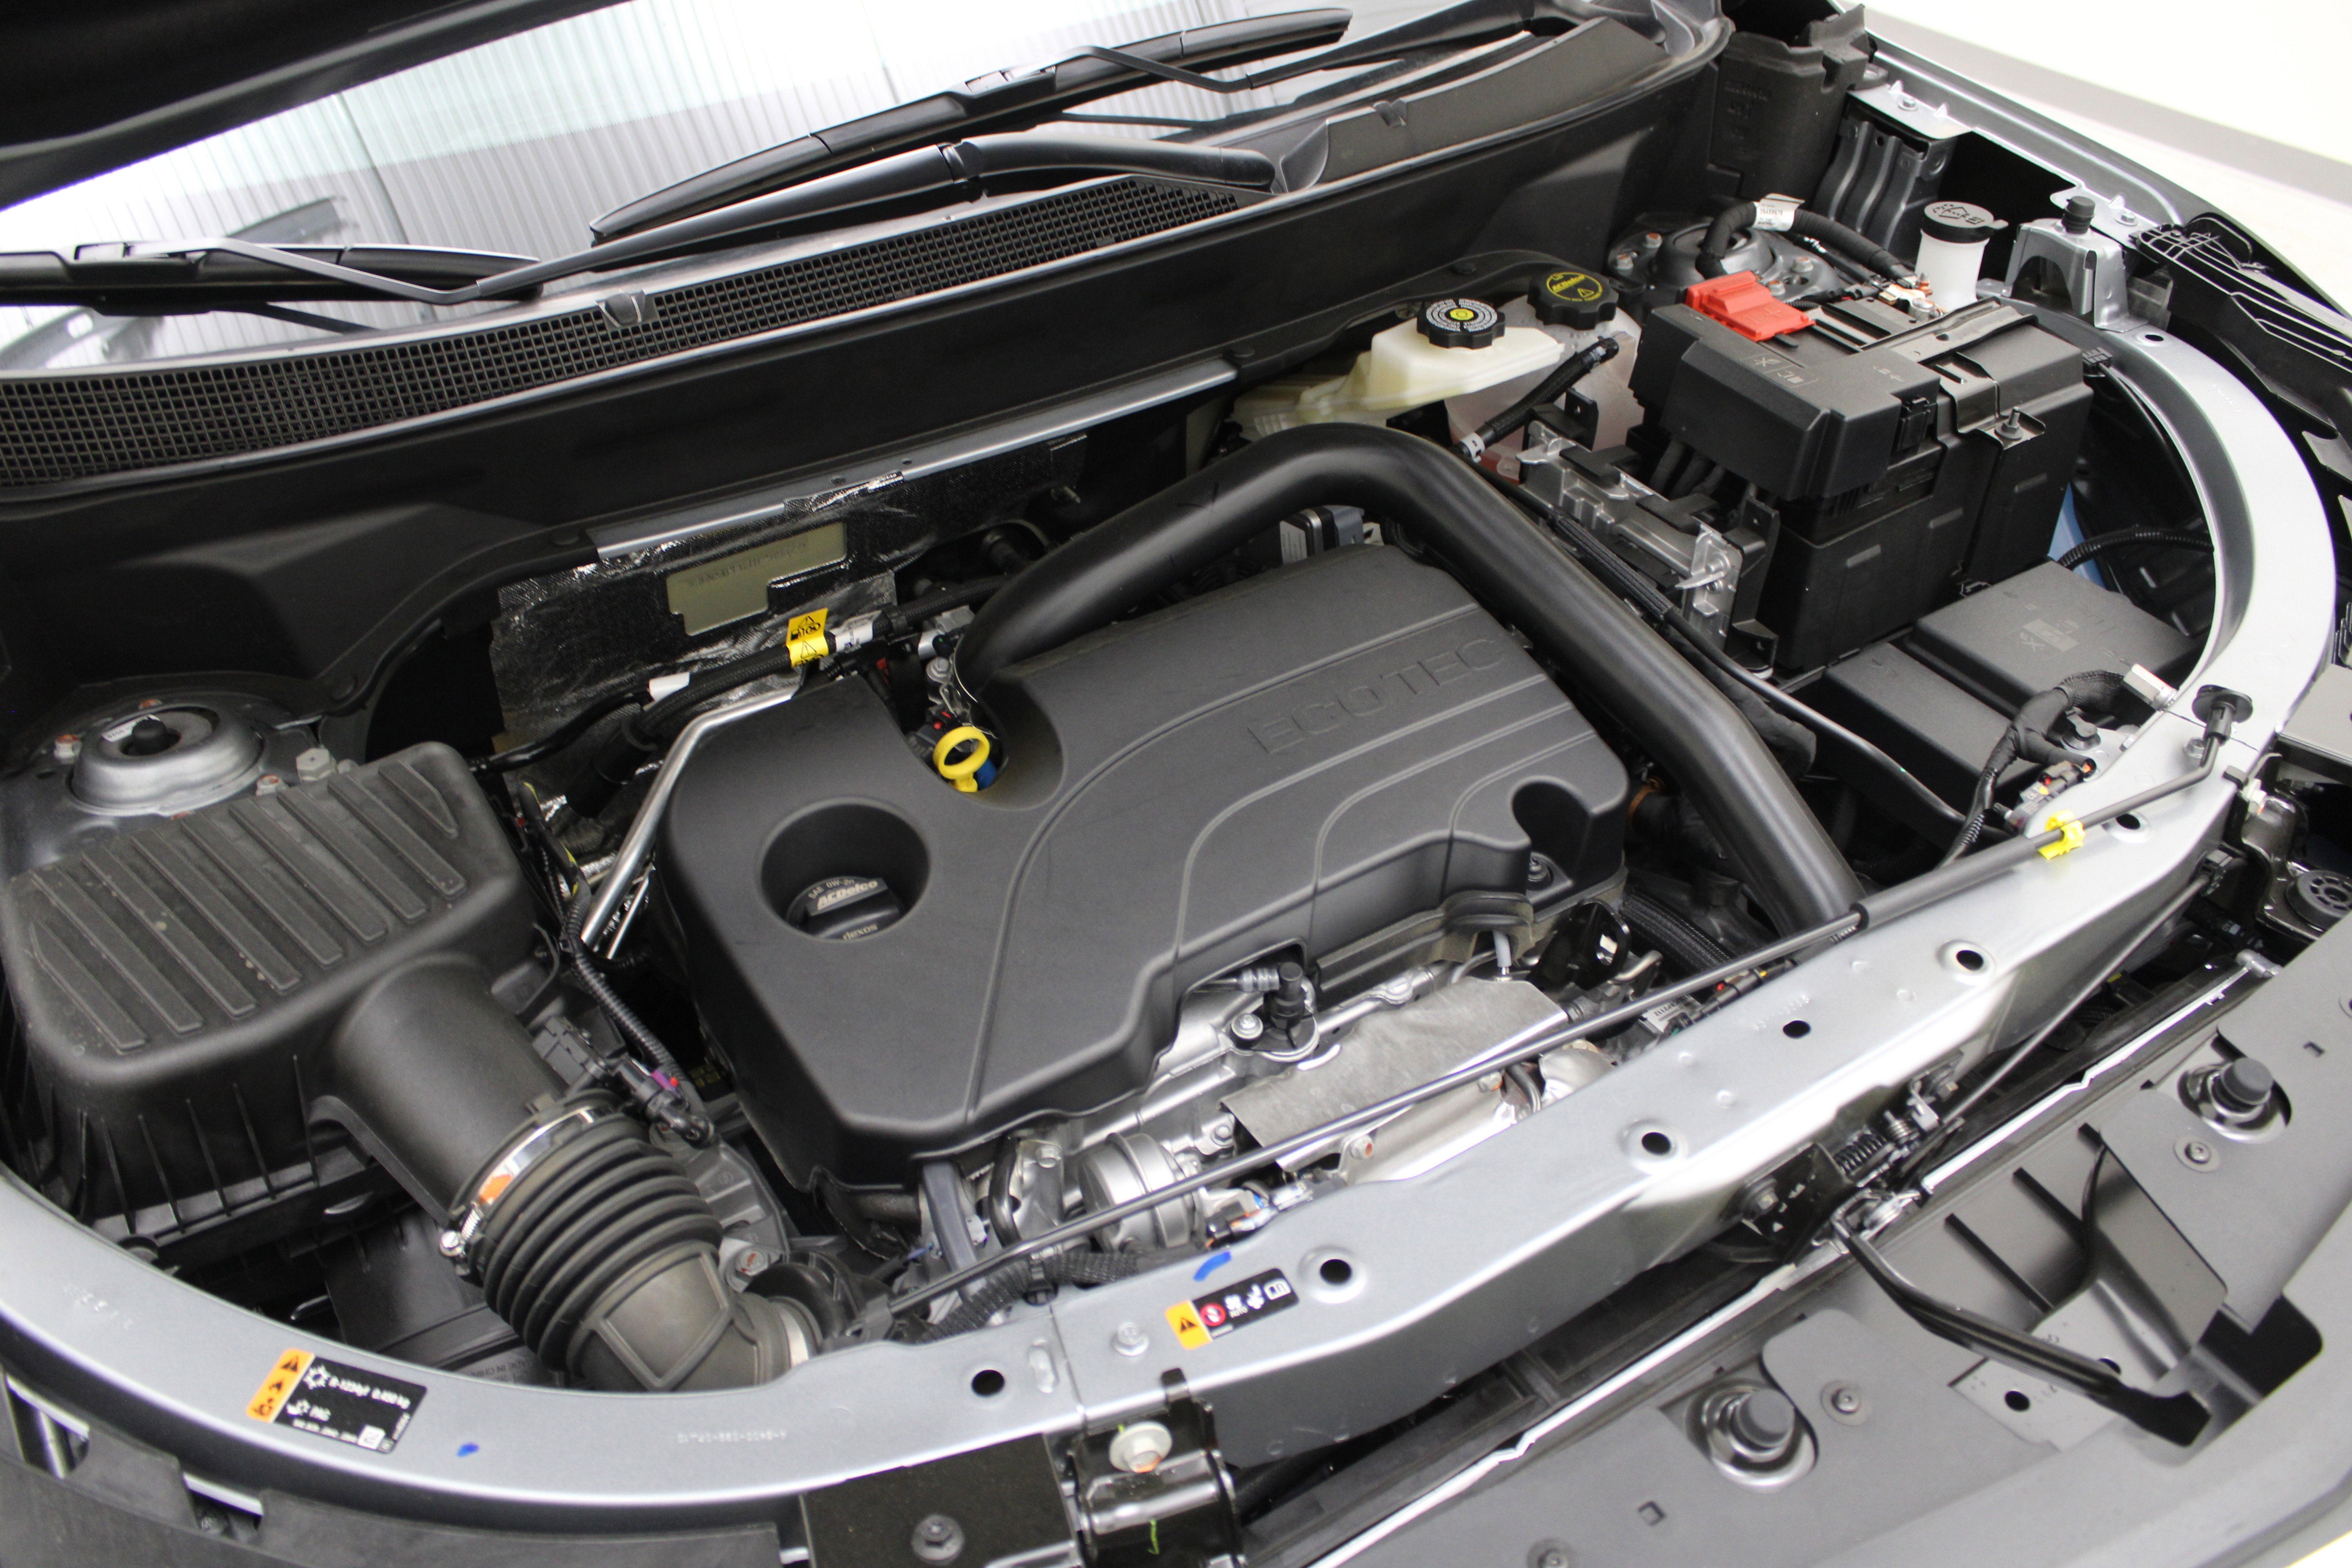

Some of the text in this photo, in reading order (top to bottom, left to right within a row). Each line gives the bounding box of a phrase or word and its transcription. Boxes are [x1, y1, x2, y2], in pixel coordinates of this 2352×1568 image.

[1247, 638, 1503, 754] ECOTEC
[817, 880, 878, 911] ACDelco
[842, 924, 878, 940] dexos
[1229, 1306, 1249, 1319] AUTO
